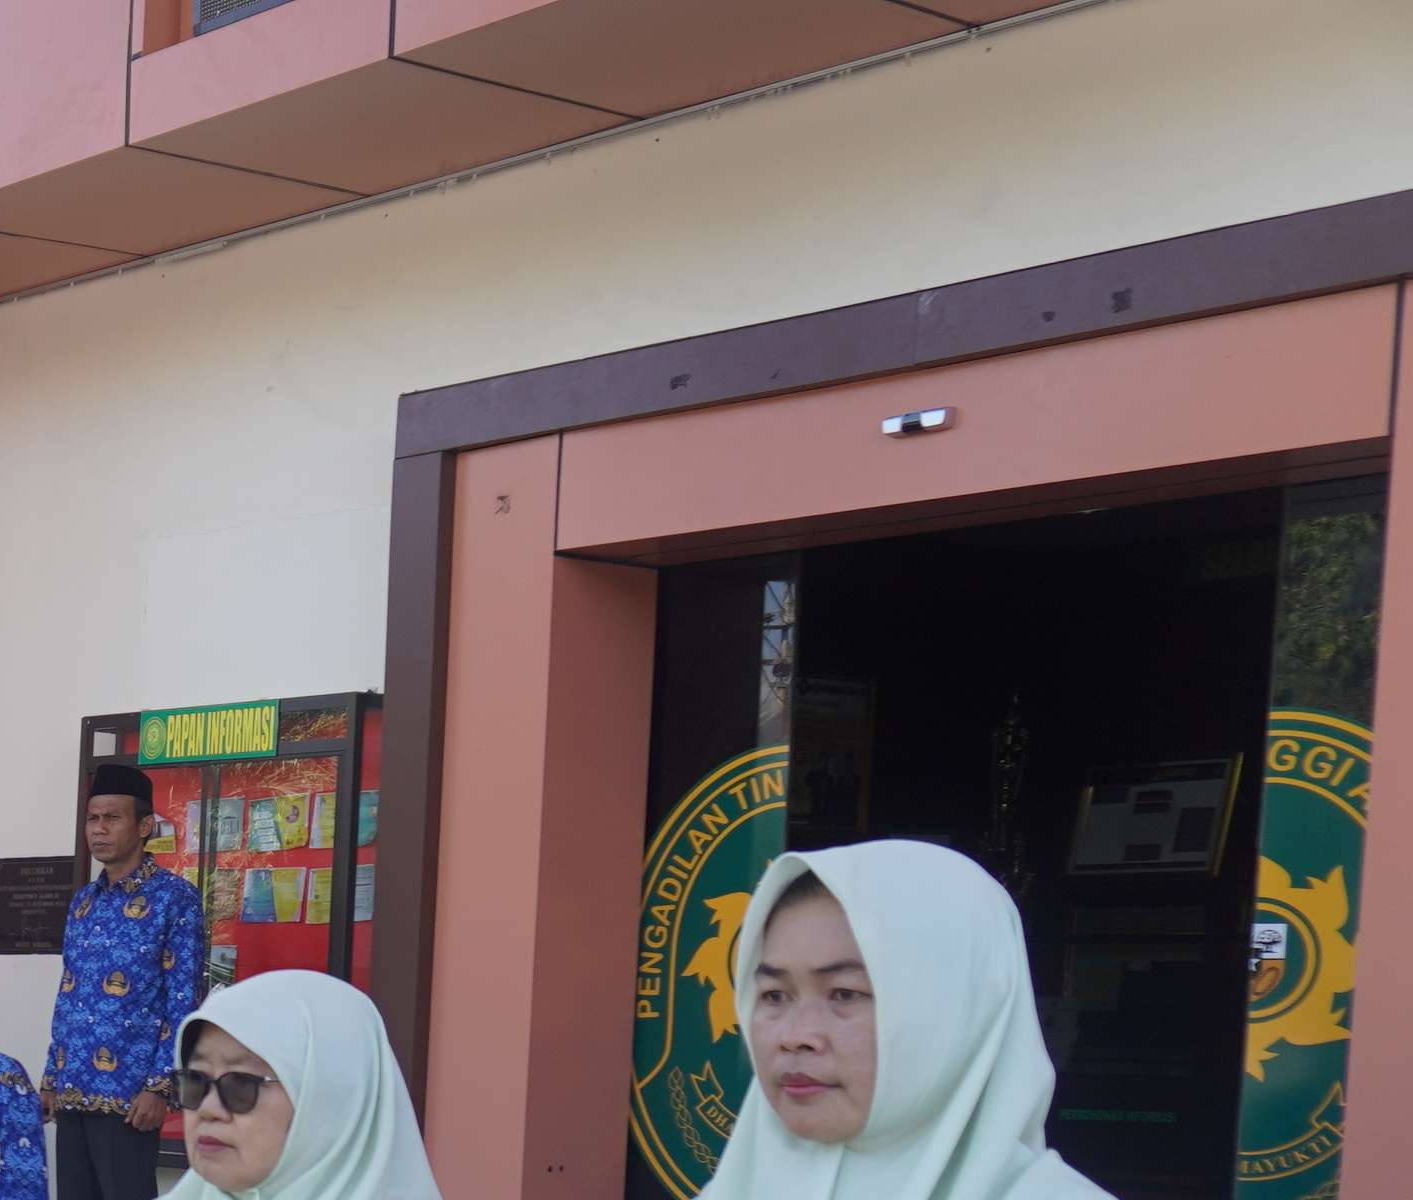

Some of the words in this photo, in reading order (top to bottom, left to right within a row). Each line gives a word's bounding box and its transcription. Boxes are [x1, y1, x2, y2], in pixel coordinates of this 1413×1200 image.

[166, 712, 205, 758] PAPAN
[206, 705, 275, 755] INFORMASI
[636, 803, 729, 1019] PENGADILAN
